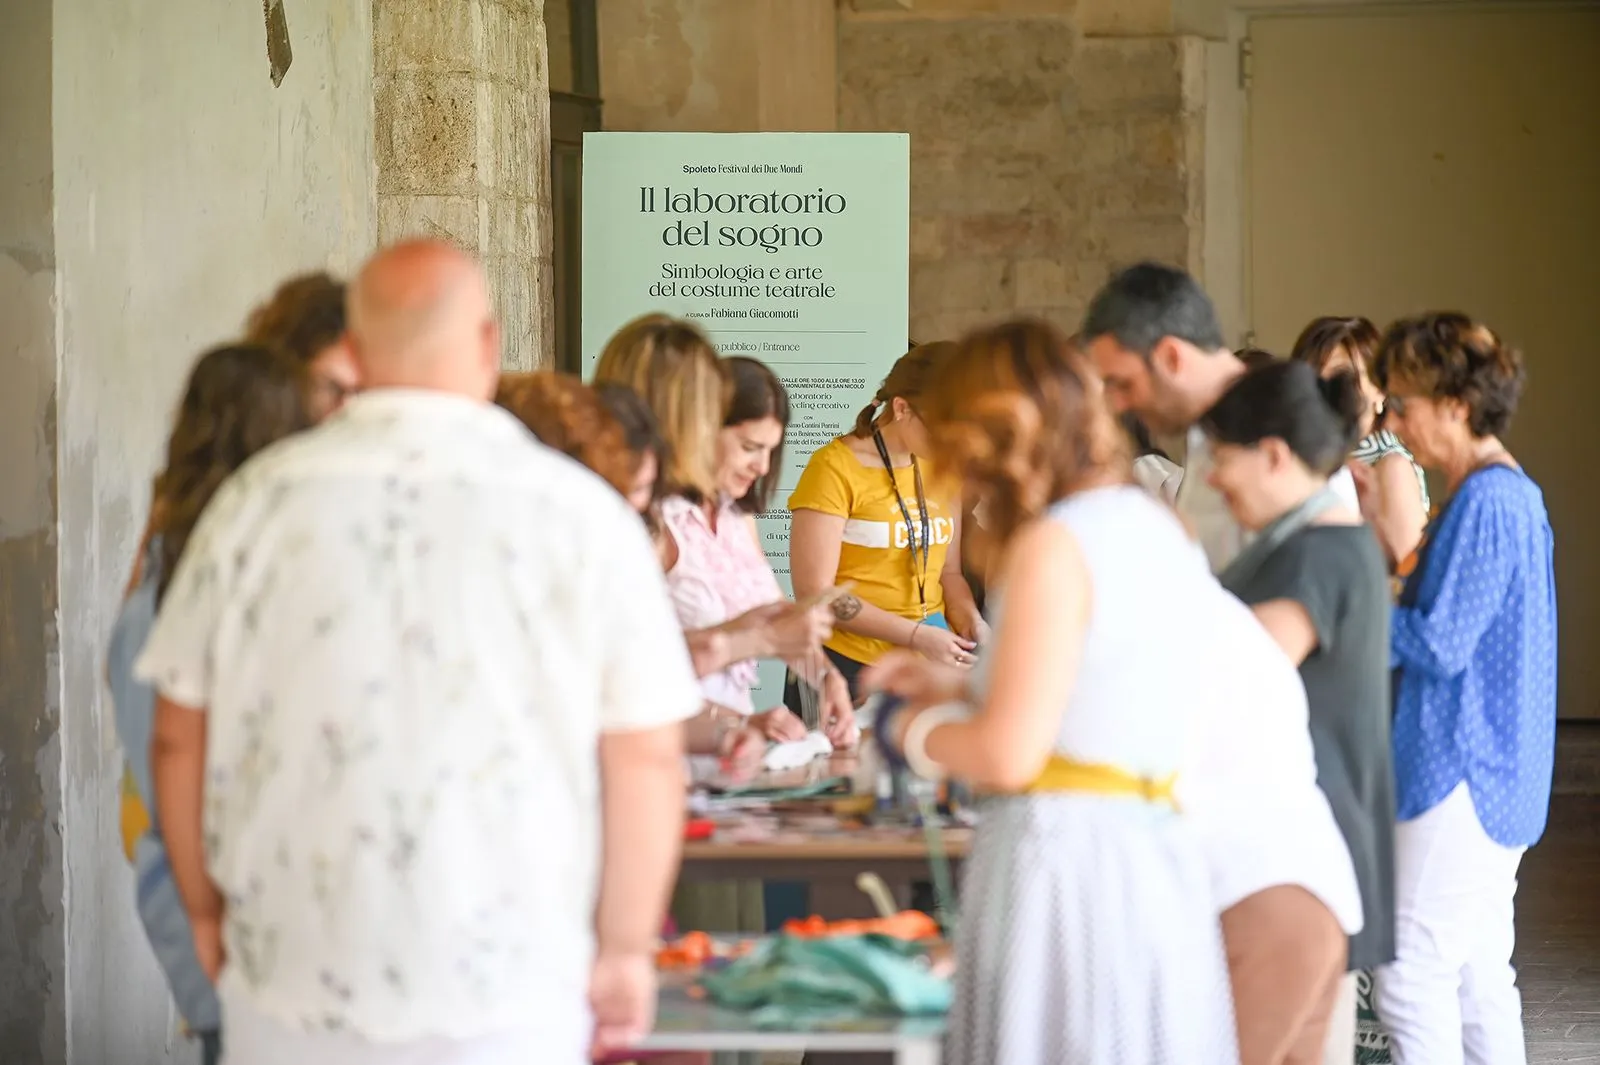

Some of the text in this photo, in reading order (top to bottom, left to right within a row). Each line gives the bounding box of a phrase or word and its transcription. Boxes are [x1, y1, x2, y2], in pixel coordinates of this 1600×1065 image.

[682, 164, 803, 174] Spoleto Festival dei Due Mondi
[640, 187, 847, 214] Il laboratorio
[662, 220, 823, 254] del sogno
[661, 262, 823, 283] Simbologia e arte
[649, 282, 836, 298] del costume teatrale
[711, 308, 747, 319] Fabiana
[749, 308, 799, 319] Giacomotti
[721, 342, 757, 352] pubblico
[763, 342, 800, 352] Entrance
